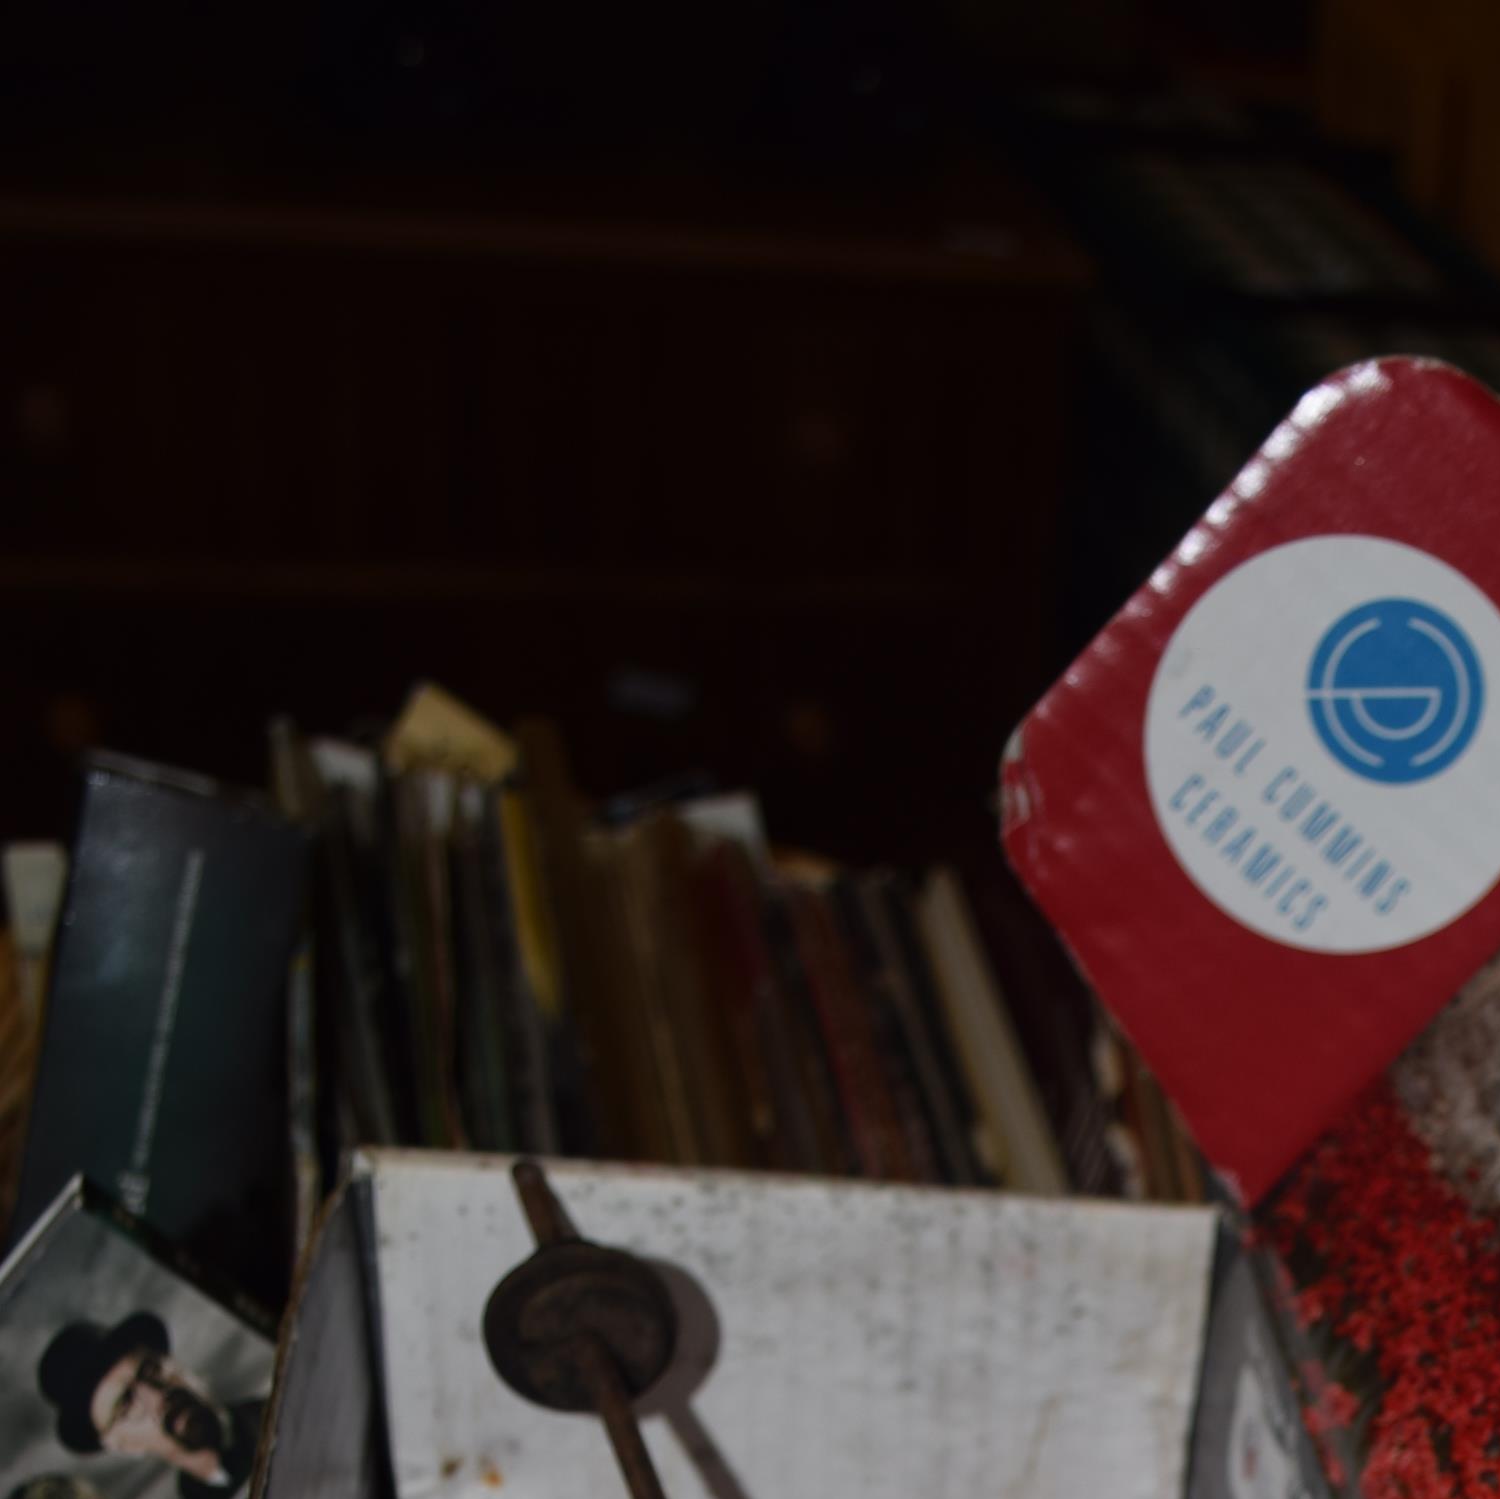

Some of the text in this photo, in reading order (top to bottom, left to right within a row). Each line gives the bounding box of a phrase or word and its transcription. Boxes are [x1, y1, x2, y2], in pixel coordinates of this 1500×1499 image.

[1167, 775, 1331, 932] CERAMICS
[1178, 685, 1414, 919] PAUL CUMMINS
